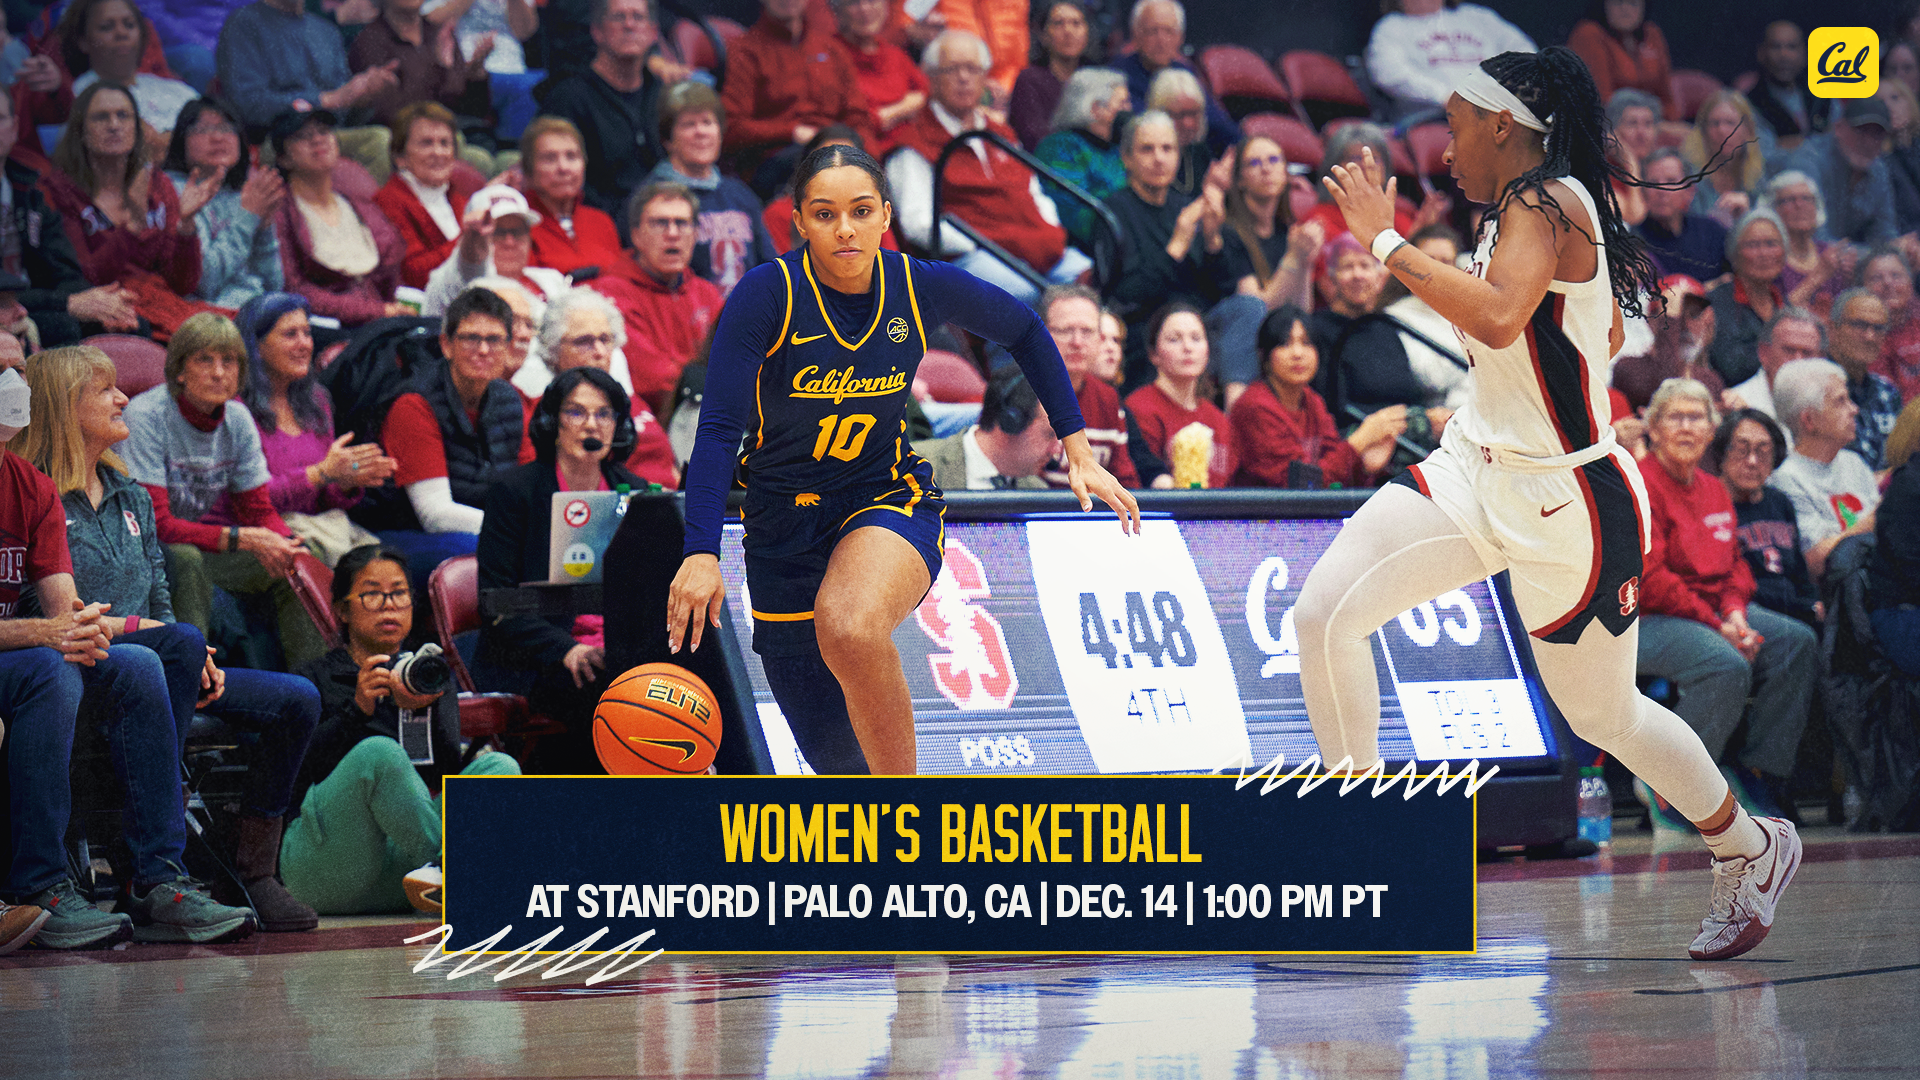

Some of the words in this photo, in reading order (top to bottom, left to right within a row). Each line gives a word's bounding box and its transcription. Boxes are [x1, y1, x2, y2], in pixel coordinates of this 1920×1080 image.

[789, 365, 907, 405] California
[812, 414, 877, 462] 10
[1079, 591, 1197, 669] 4:48
[645, 682, 711, 726] ELITE
[1127, 687, 1192, 724] 4TH
[959, 735, 1036, 768] POSS
[1494, 721, 1513, 748] 2
